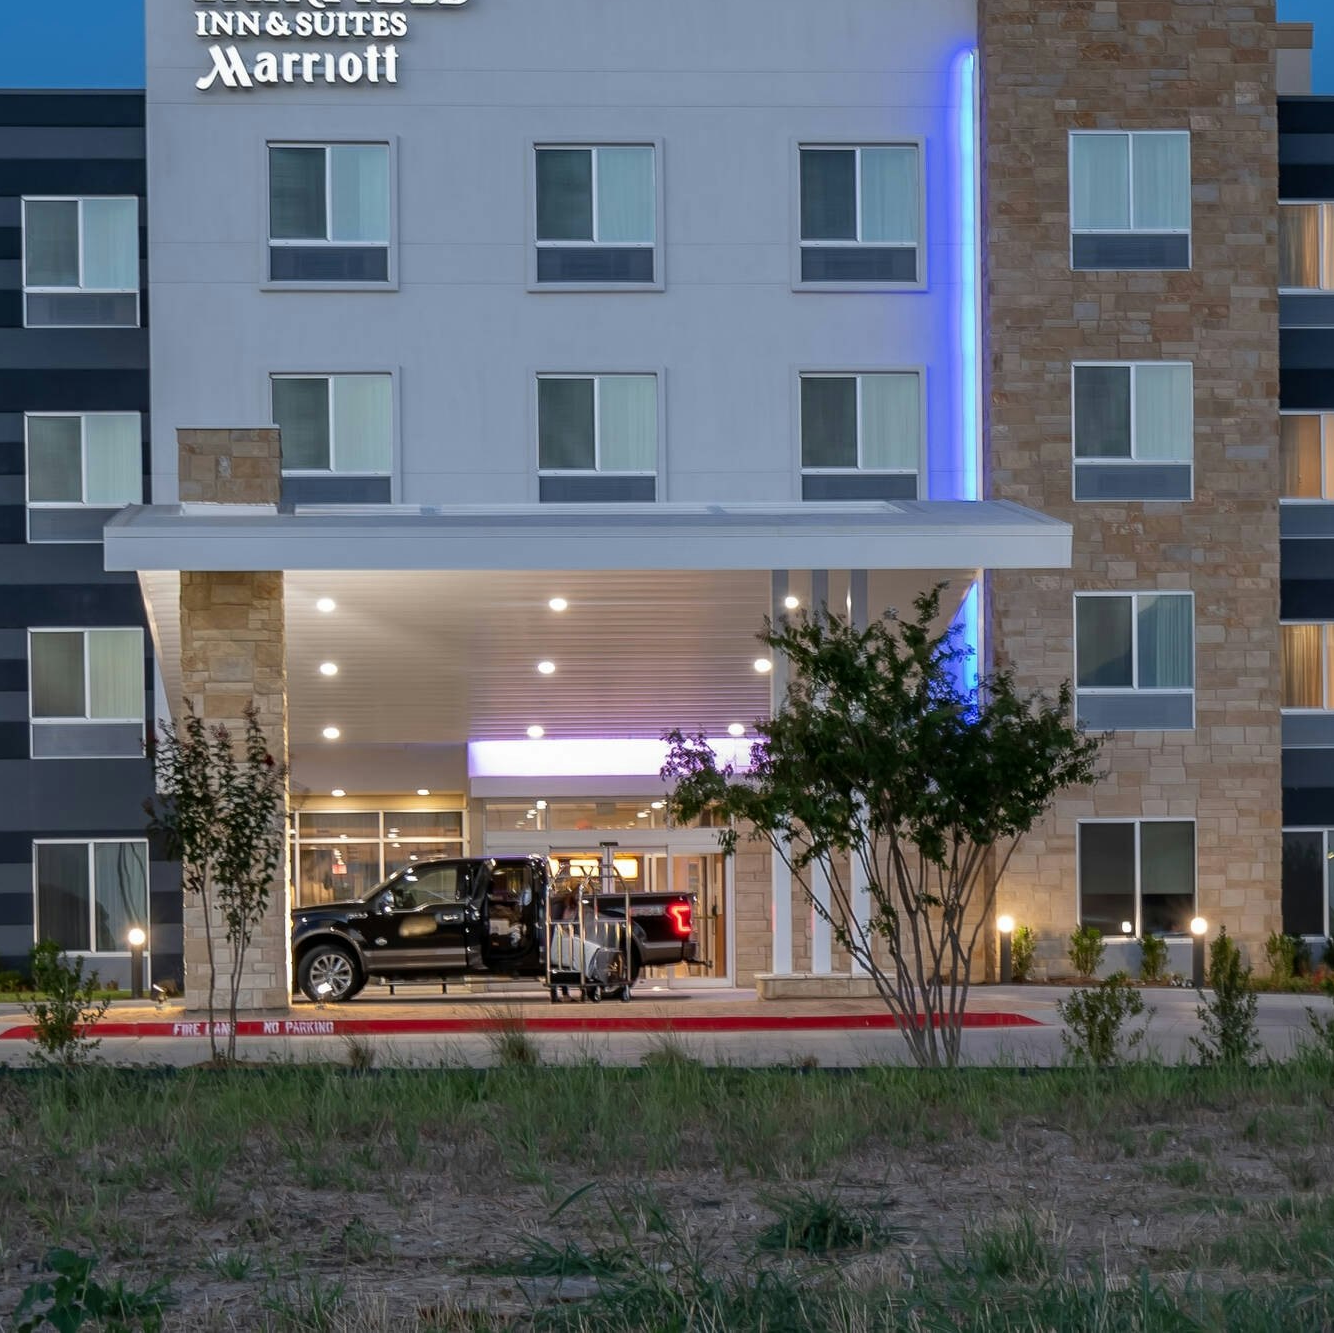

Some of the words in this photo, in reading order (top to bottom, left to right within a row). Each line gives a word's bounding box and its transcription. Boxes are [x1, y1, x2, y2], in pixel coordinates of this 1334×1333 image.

[195, 44, 399, 90] Marriott
[173, 1023, 200, 1036] FIRE
[263, 1022, 279, 1036] NO
[285, 1021, 335, 1036] PARKING
